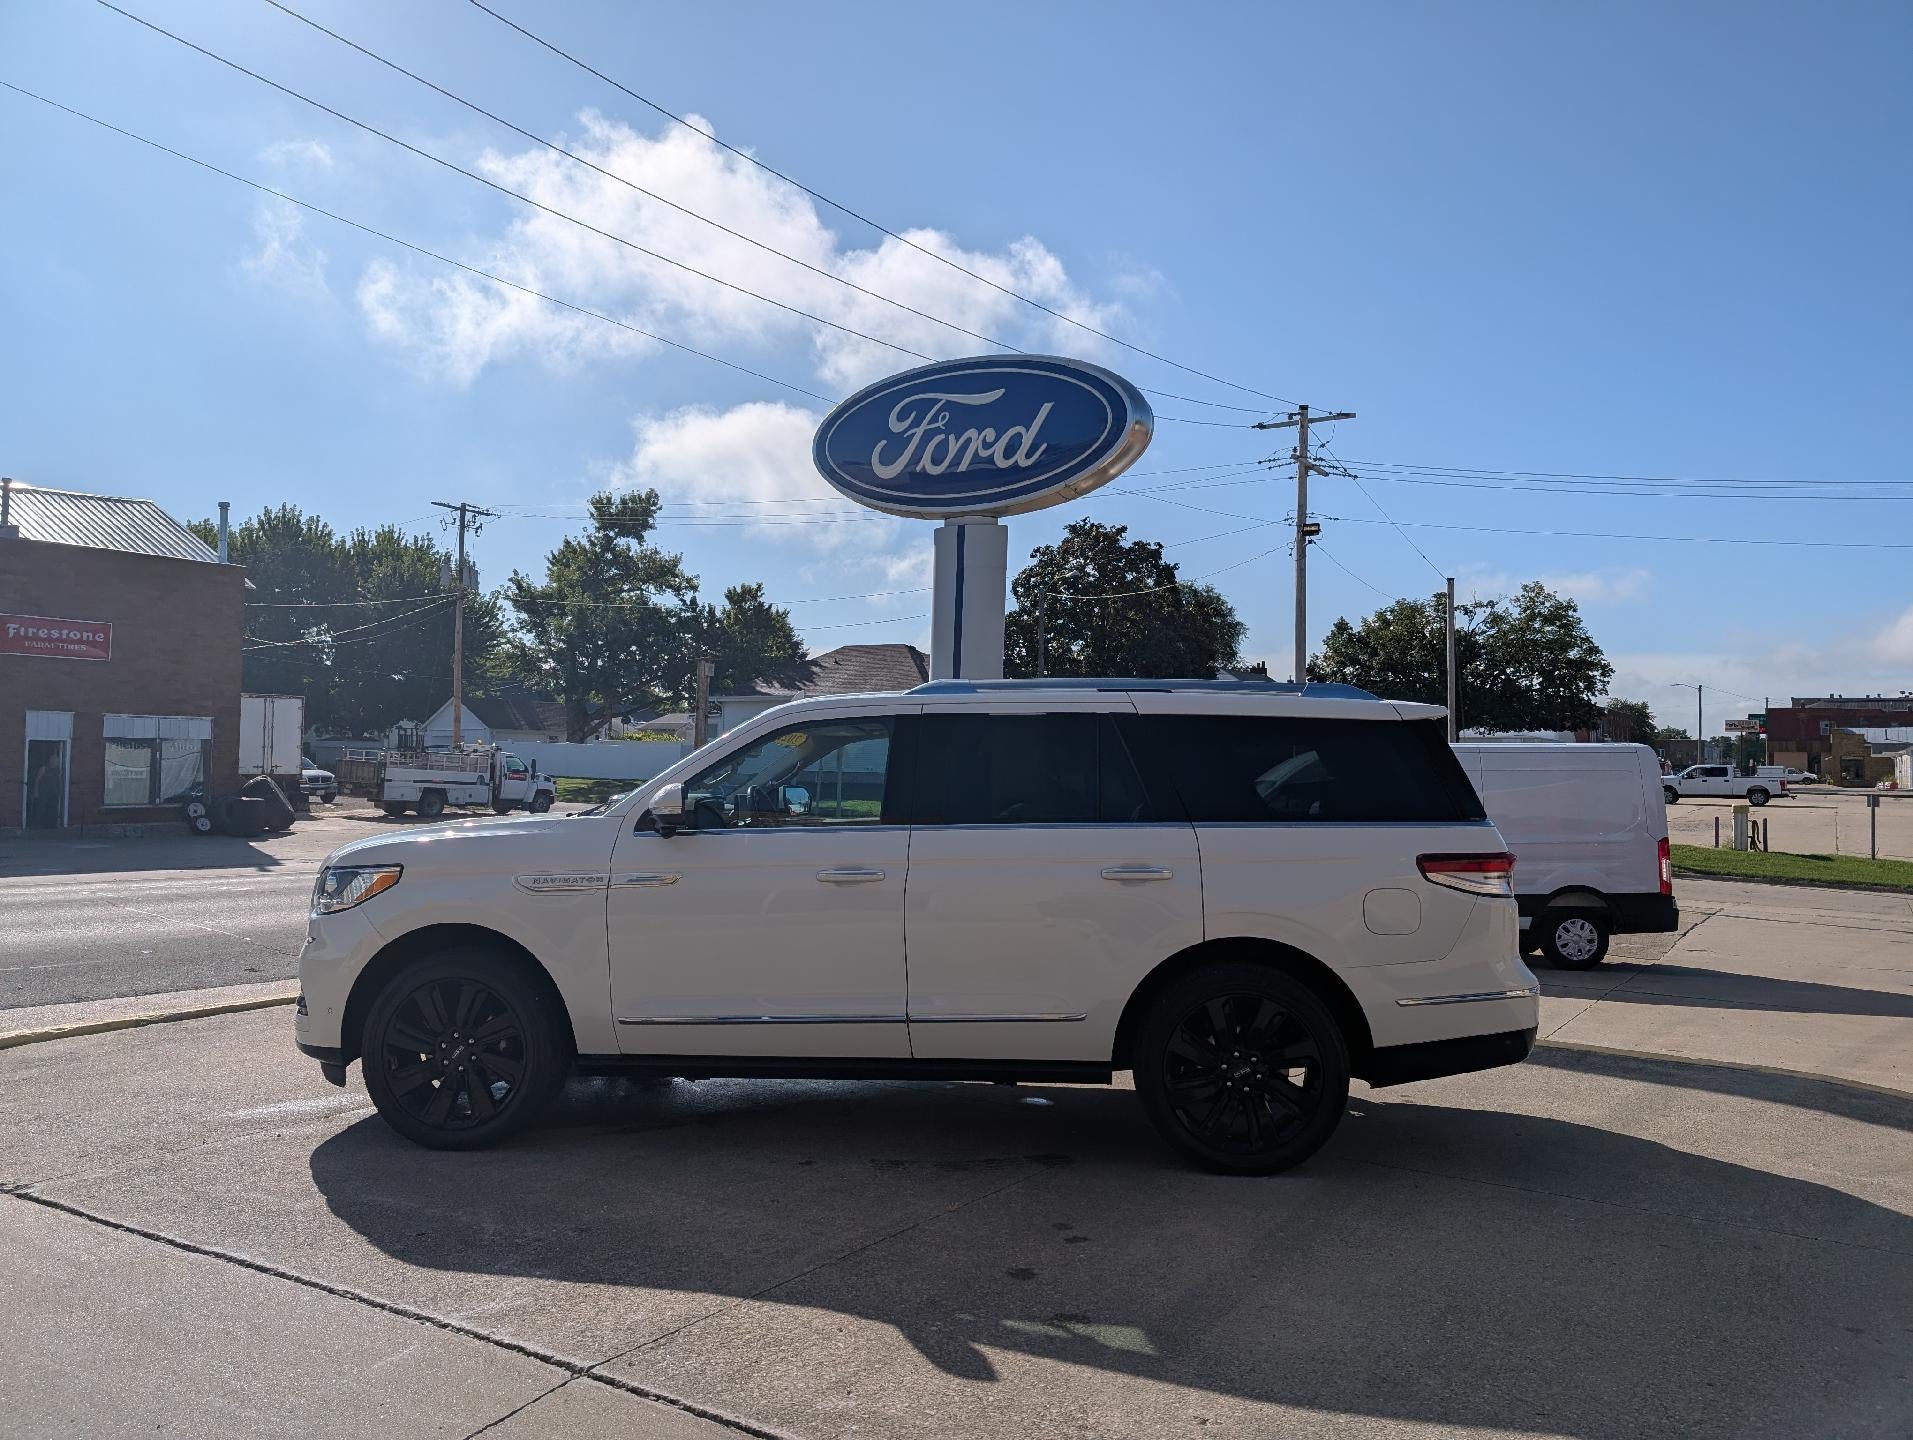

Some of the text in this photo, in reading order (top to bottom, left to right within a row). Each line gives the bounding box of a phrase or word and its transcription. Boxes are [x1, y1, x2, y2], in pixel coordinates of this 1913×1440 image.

[871, 388, 1055, 480] Ford
[6, 623, 105, 642] Firestone
[24, 641, 88, 651] FARM TIRES
[532, 876, 604, 885] NAVIGATOR
